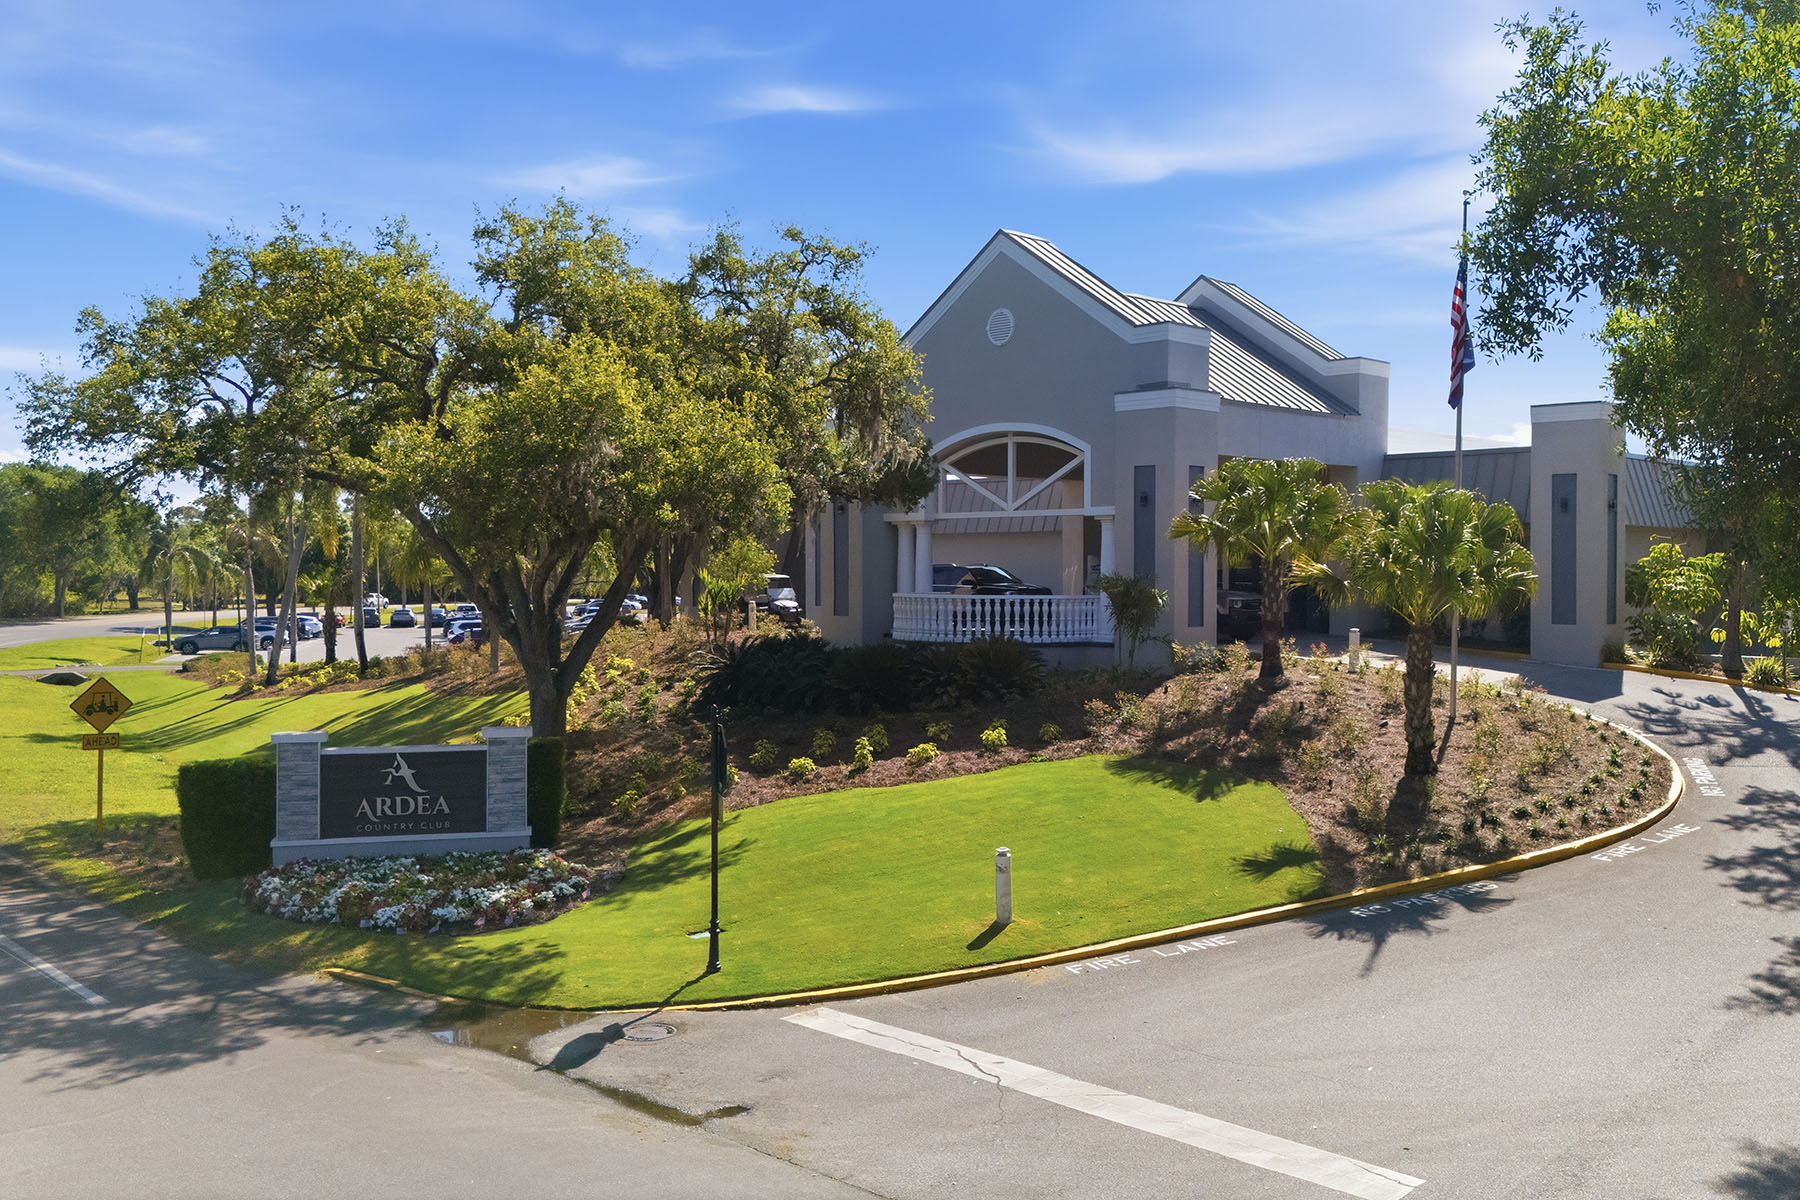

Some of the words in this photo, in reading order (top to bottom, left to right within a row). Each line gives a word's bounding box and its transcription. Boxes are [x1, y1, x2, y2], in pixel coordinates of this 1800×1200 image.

[85, 736, 117, 747] AHEAD
[354, 795, 451, 822] ARDEA
[356, 822, 414, 832] COUNTRY
[420, 821, 450, 830] CLUB
[1591, 843, 1647, 862] FIRE
[1641, 823, 1701, 843] LANE
[1350, 905, 1392, 918] NO
[1065, 954, 1141, 974] FIRE
[1152, 935, 1237, 957] LANE
